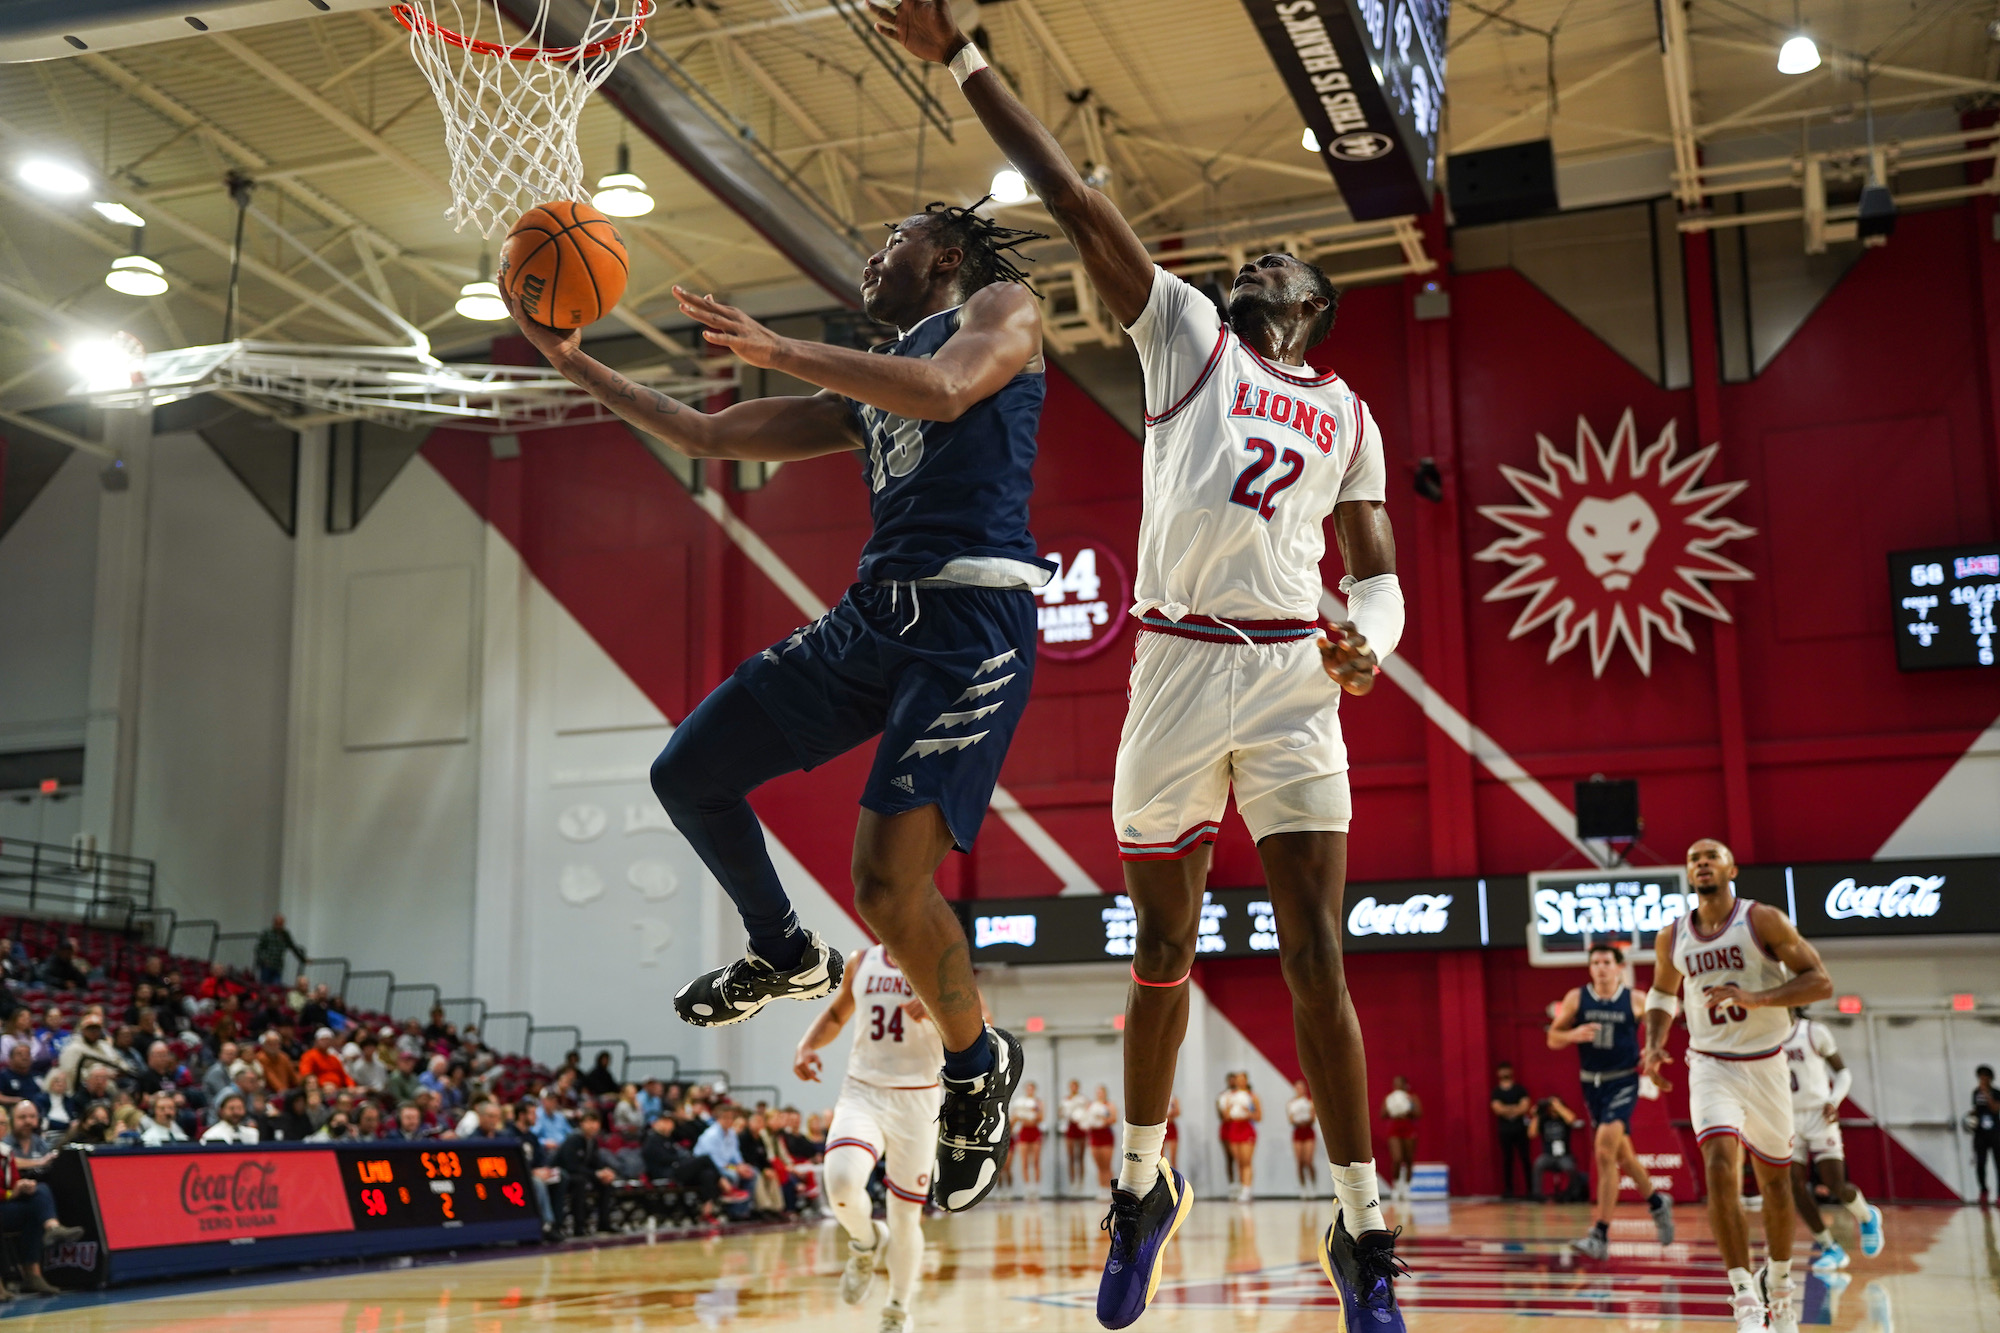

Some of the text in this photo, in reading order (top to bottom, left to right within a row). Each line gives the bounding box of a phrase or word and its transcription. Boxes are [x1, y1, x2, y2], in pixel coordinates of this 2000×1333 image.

[1275, 1, 1369, 134] THIS IS HANK'S
[1228, 379, 1339, 458] LIONS
[1229, 437, 1305, 523] 22
[1534, 884, 1734, 935] Standa
[1825, 875, 1946, 920] Coca-Cola
[1685, 945, 1743, 978] LIONS
[865, 976, 914, 996] LIONS
[870, 1005, 904, 1042] 34
[180, 1160, 280, 1215] Coca-Cola
[357, 1159, 394, 1184] LMU
[199, 1214, 277, 1232] ZERO SUGAR
[440, 1192, 455, 1219] 2
